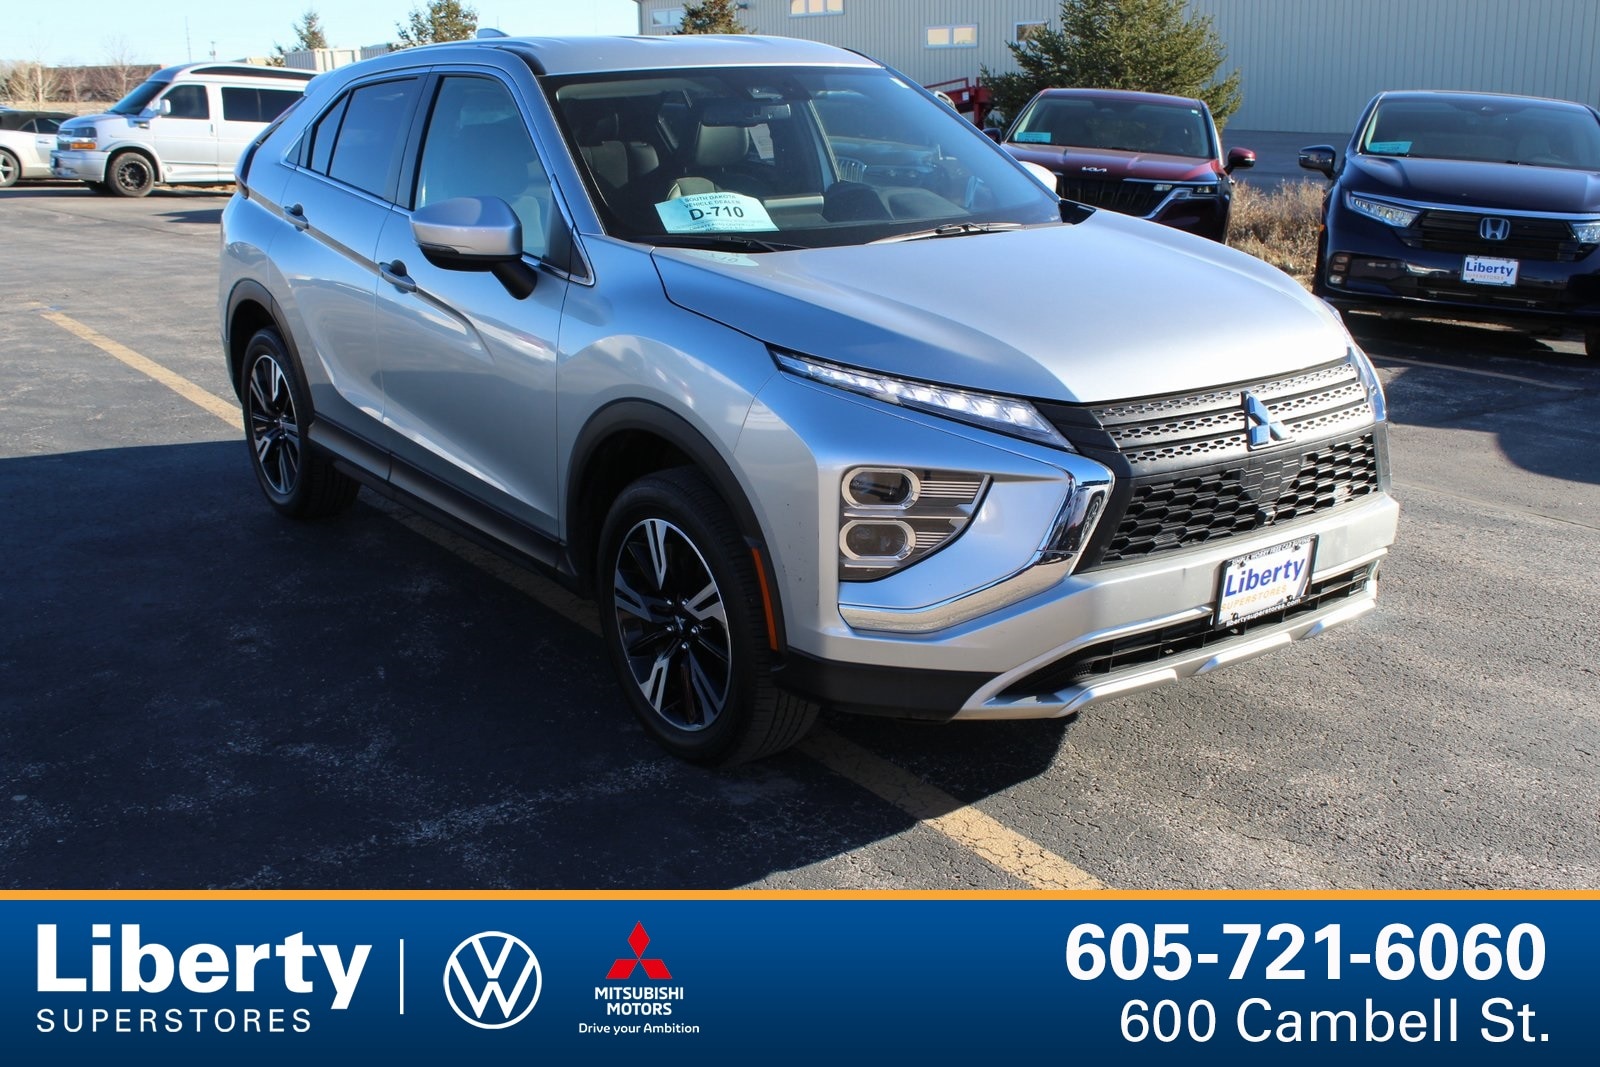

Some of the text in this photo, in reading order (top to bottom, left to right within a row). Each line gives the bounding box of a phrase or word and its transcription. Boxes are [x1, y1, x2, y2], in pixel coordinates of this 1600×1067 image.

[683, 201, 714, 209] VEHICLE
[684, 193, 737, 203] SOUTH DAKOTA
[688, 205, 745, 221] D-710
[1465, 261, 1514, 277] Liberty
[1224, 558, 1306, 598] Liberty
[1221, 584, 1288, 611] SUPERSTORES
